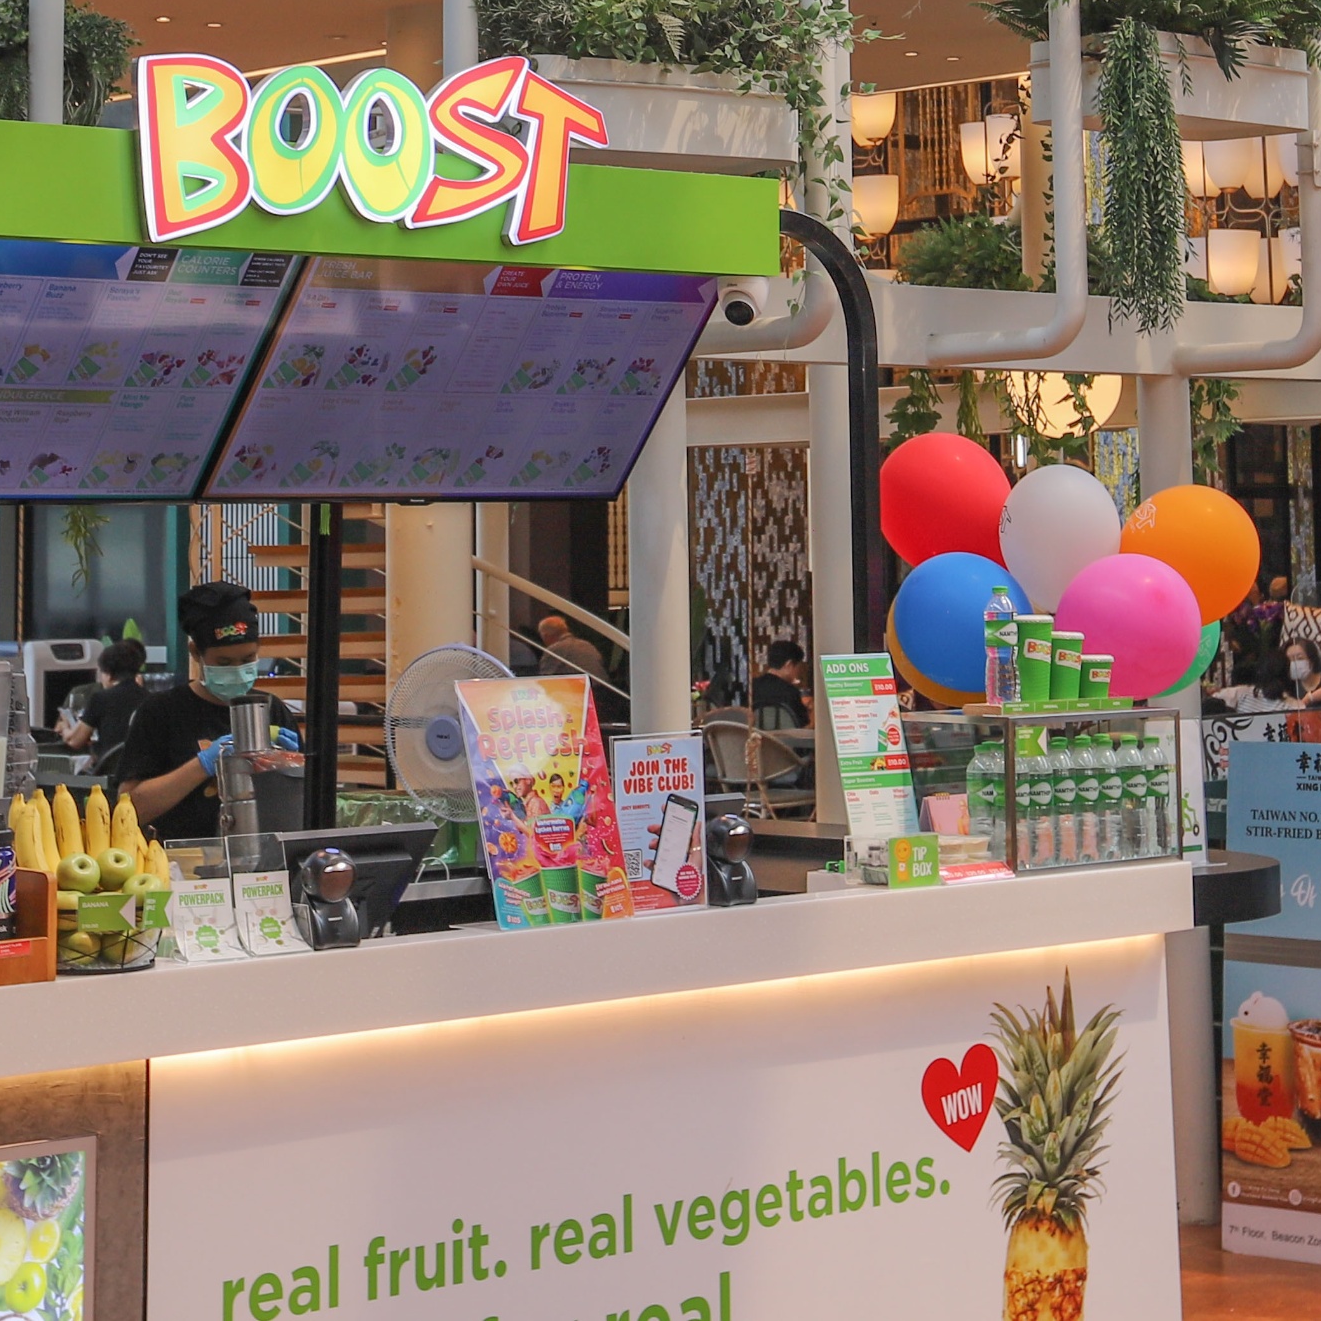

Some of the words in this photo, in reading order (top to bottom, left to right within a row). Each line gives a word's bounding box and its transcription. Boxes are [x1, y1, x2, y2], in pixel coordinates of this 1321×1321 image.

[137, 53, 610, 246] BOOST
[181, 255, 230, 266] CALORIE
[177, 265, 238, 275] COUNTERS
[560, 272, 602, 282] PROTEIN
[564, 281, 603, 290] ENERGY
[826, 663, 847, 674] ADD
[849, 662, 869, 673] ONS
[487, 704, 564, 734] Splash
[477, 728, 590, 762] Refresh
[630, 759, 660, 777] JOIN
[664, 757, 688, 774] THE
[623, 777, 654, 795] VIBE
[658, 773, 694, 792] CLUB!
[1296, 783, 1318, 792] XING
[1250, 808, 1296, 822] TAIWAN
[1246, 826, 1313, 840] STIR-FRIED
[912, 846, 928, 861] TIP
[912, 862, 932, 877] BOX
[242, 883, 284, 899] POWERPACK
[1290, 874, 1317, 908] Of
[82, 901, 110, 909] BANANA
[179, 892, 225, 906] POWERPACK
[940, 1082, 983, 1126] WOW
[222, 1244, 340, 1321] real
[363, 1218, 508, 1301] fruit.
[530, 1195, 634, 1270] real
[654, 1151, 951, 1247] vegetables.
[1241, 1226, 1266, 1241] Floor,
[1271, 1230, 1306, 1244] Beacon
